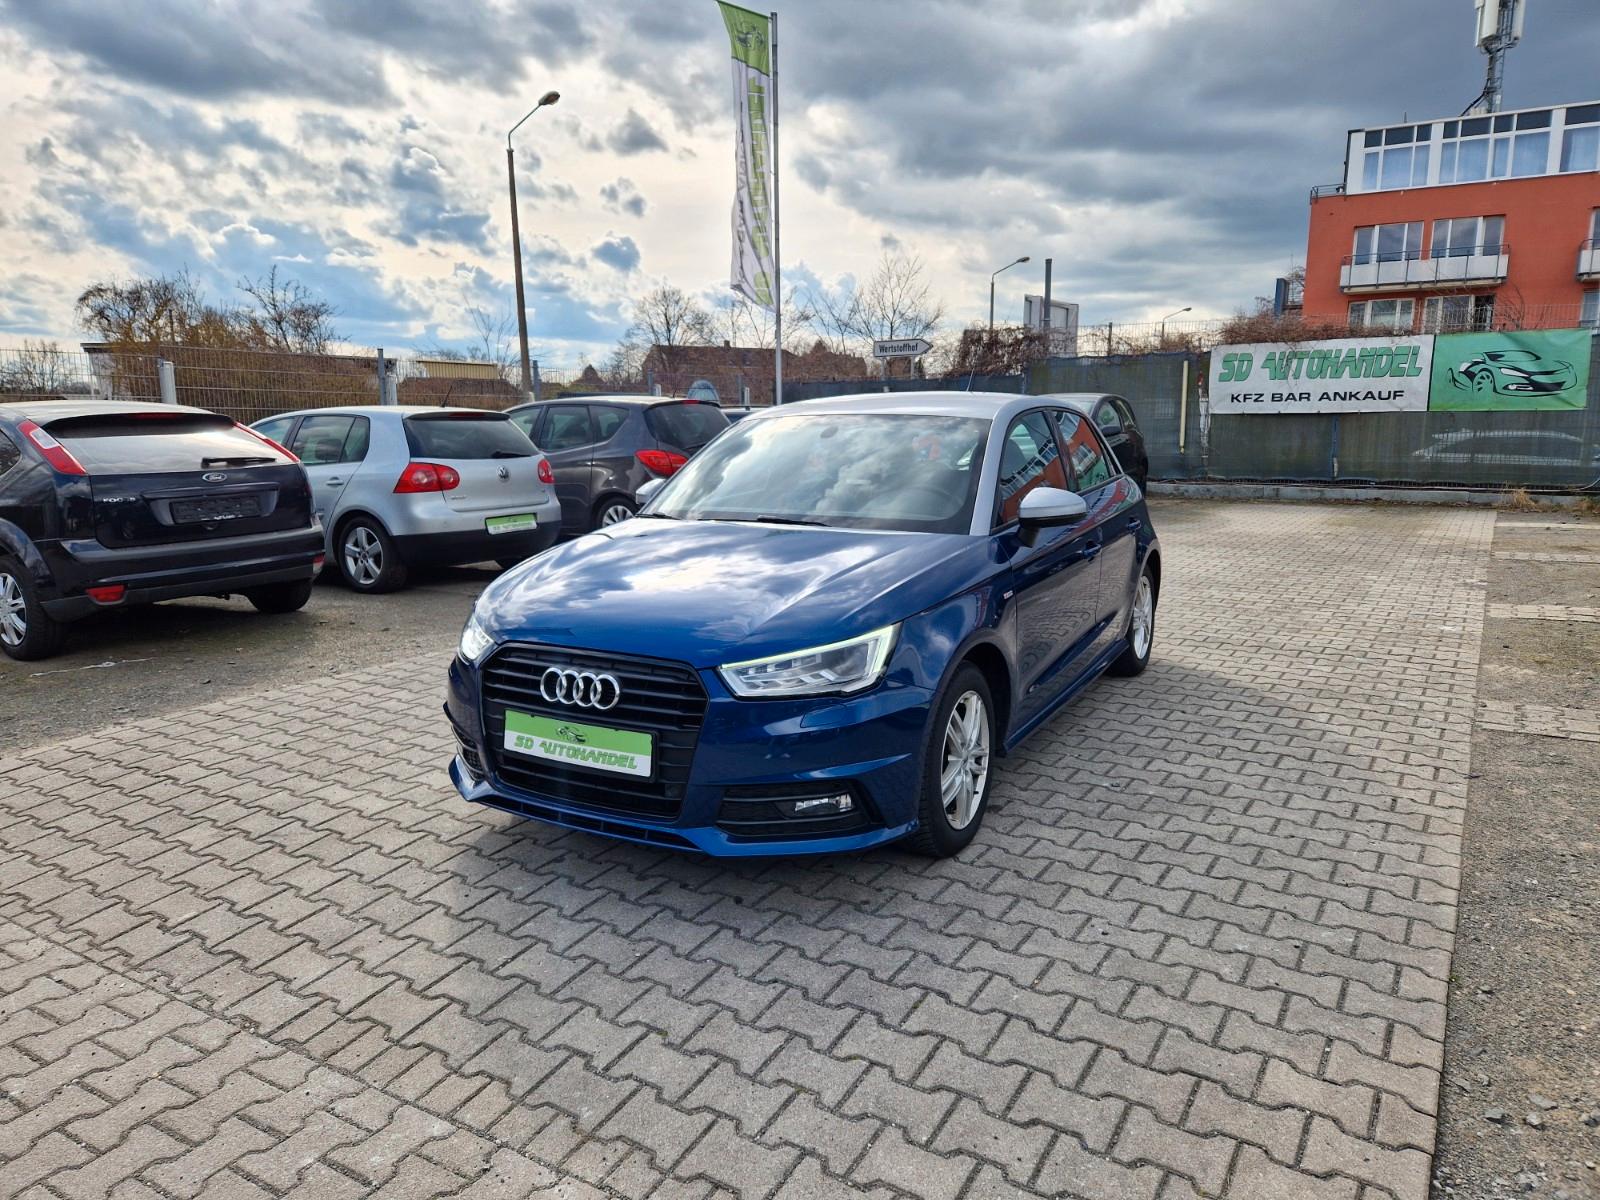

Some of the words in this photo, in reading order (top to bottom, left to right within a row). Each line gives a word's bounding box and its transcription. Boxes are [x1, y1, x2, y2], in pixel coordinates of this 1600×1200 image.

[879, 342, 919, 353] Wertstoffhof
[1218, 352, 1254, 382] SD
[1261, 345, 1423, 381] AUTOHANDEL
[1231, 393, 1264, 403] KFZ
[1271, 392, 1311, 402] BAR
[1318, 390, 1405, 402] ANKAUF
[514, 735, 534, 750] SD
[539, 741, 638, 769] AUTOHANDEL
